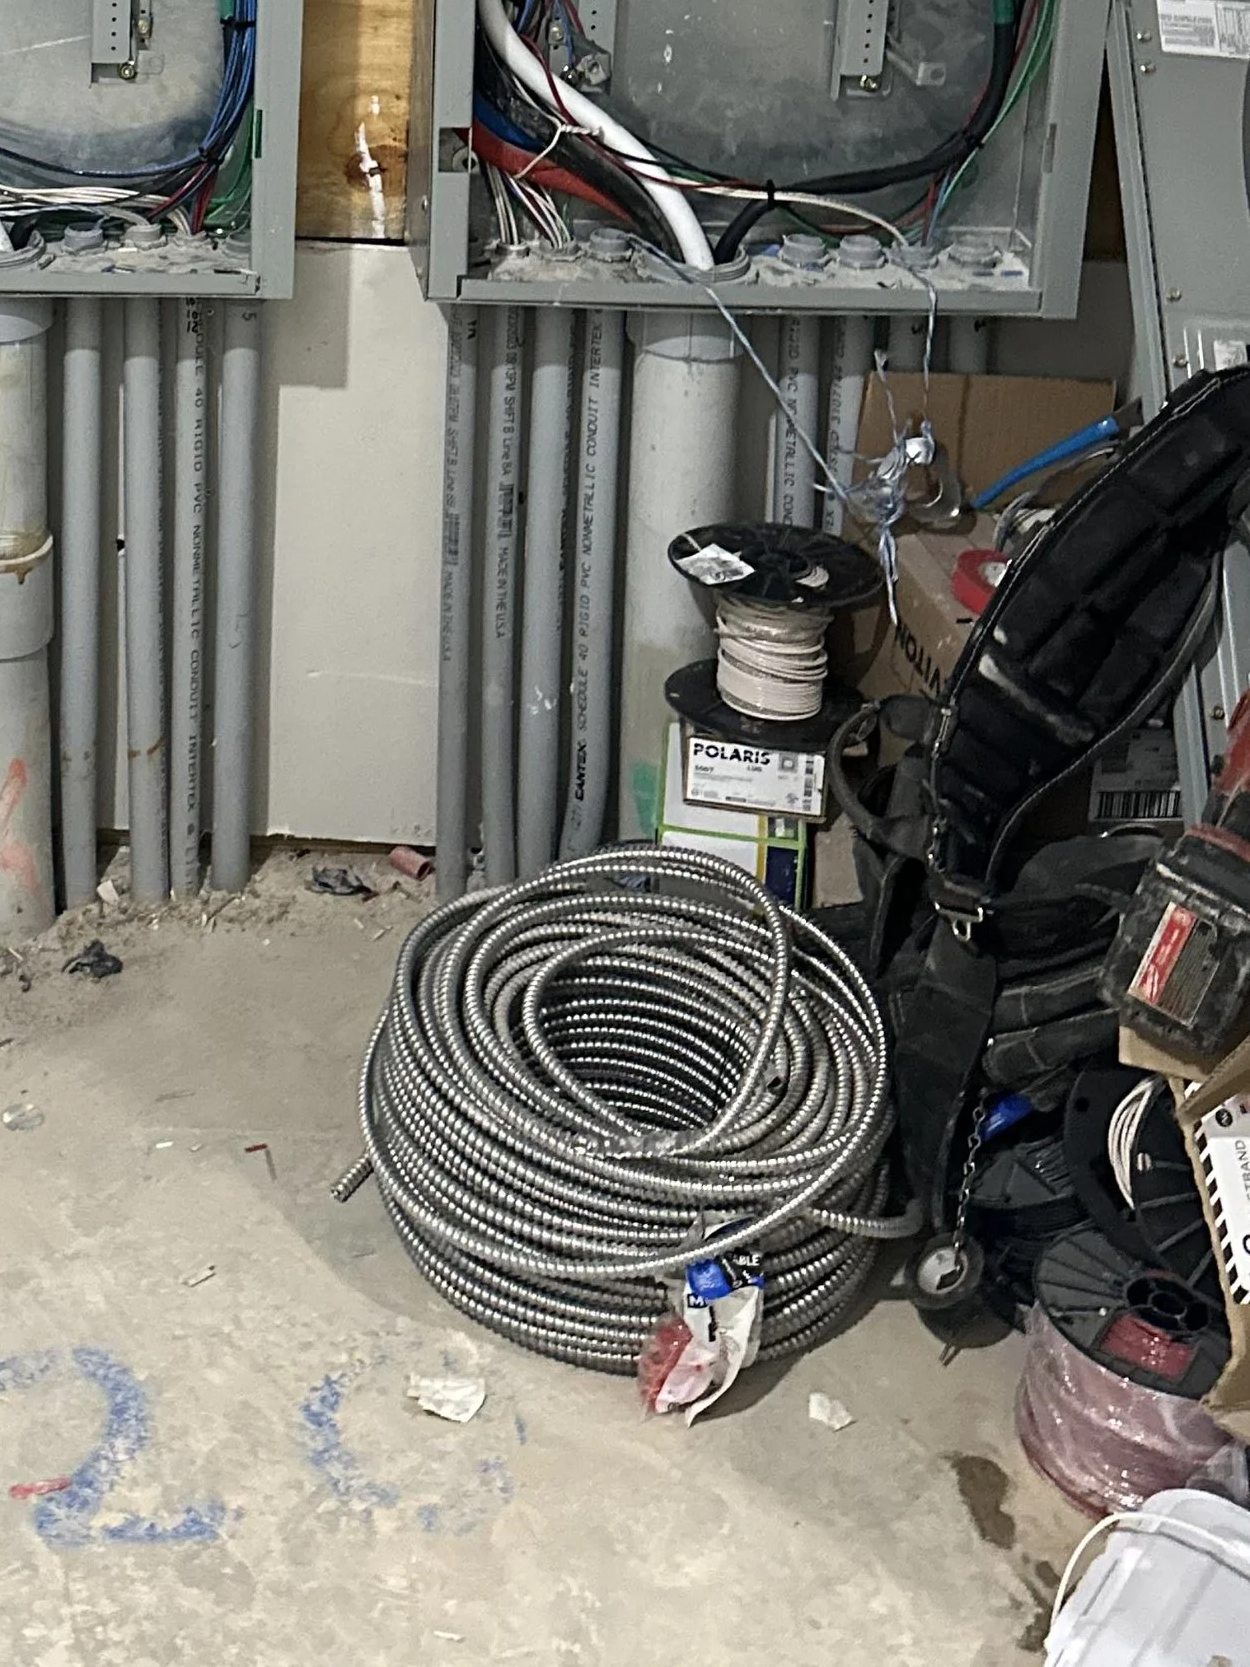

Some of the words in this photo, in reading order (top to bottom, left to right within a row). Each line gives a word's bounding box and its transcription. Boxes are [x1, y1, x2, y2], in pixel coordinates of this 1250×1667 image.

[787, 367, 799, 391] PVC
[194, 387, 204, 408] 40
[504, 396, 517, 424] SHIFT
[503, 426, 514, 434] B
[586, 397, 598, 457] CONDUIT
[193, 419, 203, 473] RIGID
[502, 437, 514, 460] Line
[193, 483, 203, 514] PVC
[580, 463, 596, 555] NONMETALLIC
[499, 547, 510, 576] MADE
[579, 562, 591, 589] PVC
[191, 525, 203, 639] NONMETALLIC
[497, 578, 508, 589] IN
[496, 591, 507, 613] THE
[578, 595, 590, 637] RIGID
[578, 644, 589, 661] 40
[189, 650, 200, 721] CONDUIT
[576, 668, 588, 731] SCHEDULE
[693, 742, 771, 766] POLARIS
[574, 741, 587, 801] CANTEX
[733, 1254, 761, 1267] ABLE
